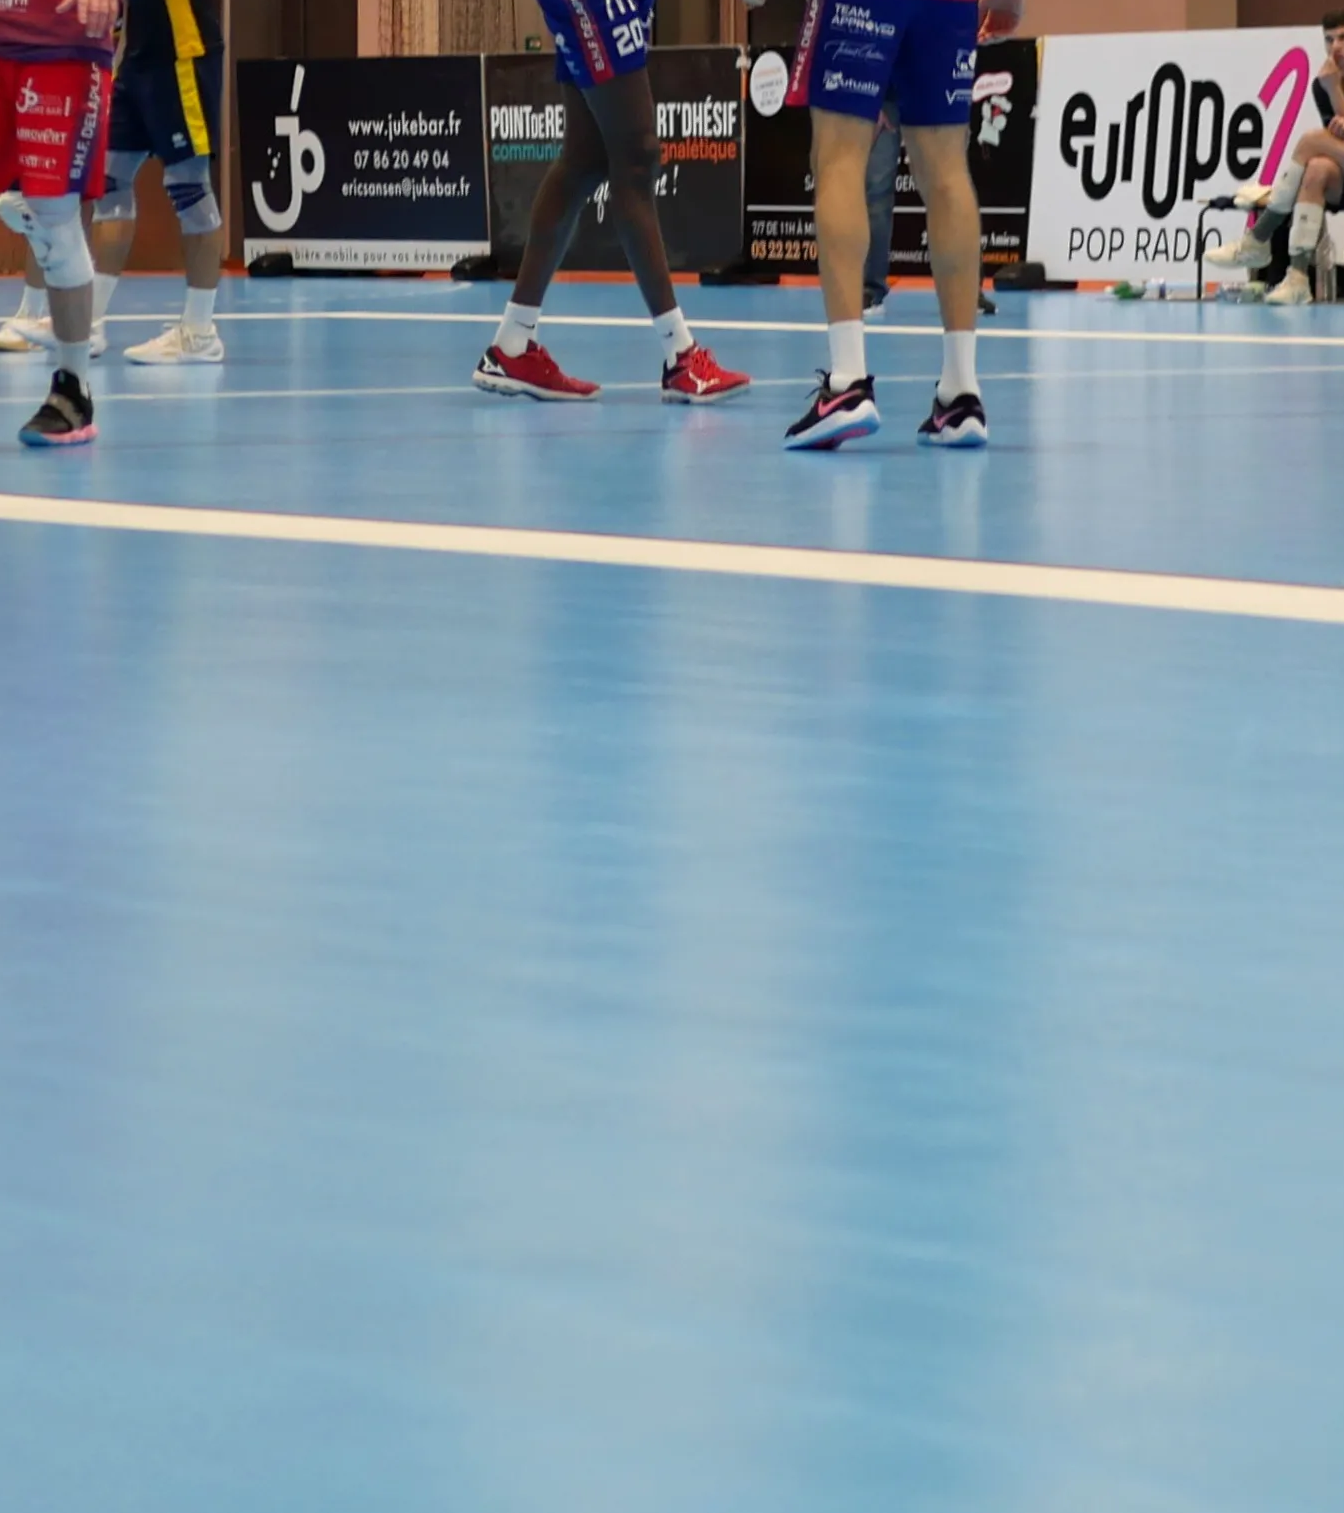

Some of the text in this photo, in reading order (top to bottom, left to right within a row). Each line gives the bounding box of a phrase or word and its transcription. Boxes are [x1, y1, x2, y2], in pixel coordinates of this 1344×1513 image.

[835, 2, 871, 20] TEAM
[612, 17, 644, 58] 20
[831, 14, 896, 37] APPROVED
[347, 109, 462, 143] www.jukebar.fr
[656, 93, 738, 138] RT'DHÉSIF
[354, 149, 450, 170] 07 86 20 49 04
[659, 137, 737, 165] gnalétique
[341, 175, 471, 202] ericsansen@jukebar.fr
[324, 244, 359, 262] mobile
[363, 250, 388, 266] pour
[391, 251, 410, 264] vos
[767, 239, 784, 261] 22
[784, 239, 801, 261] 22
[1068, 226, 1125, 262] POP
